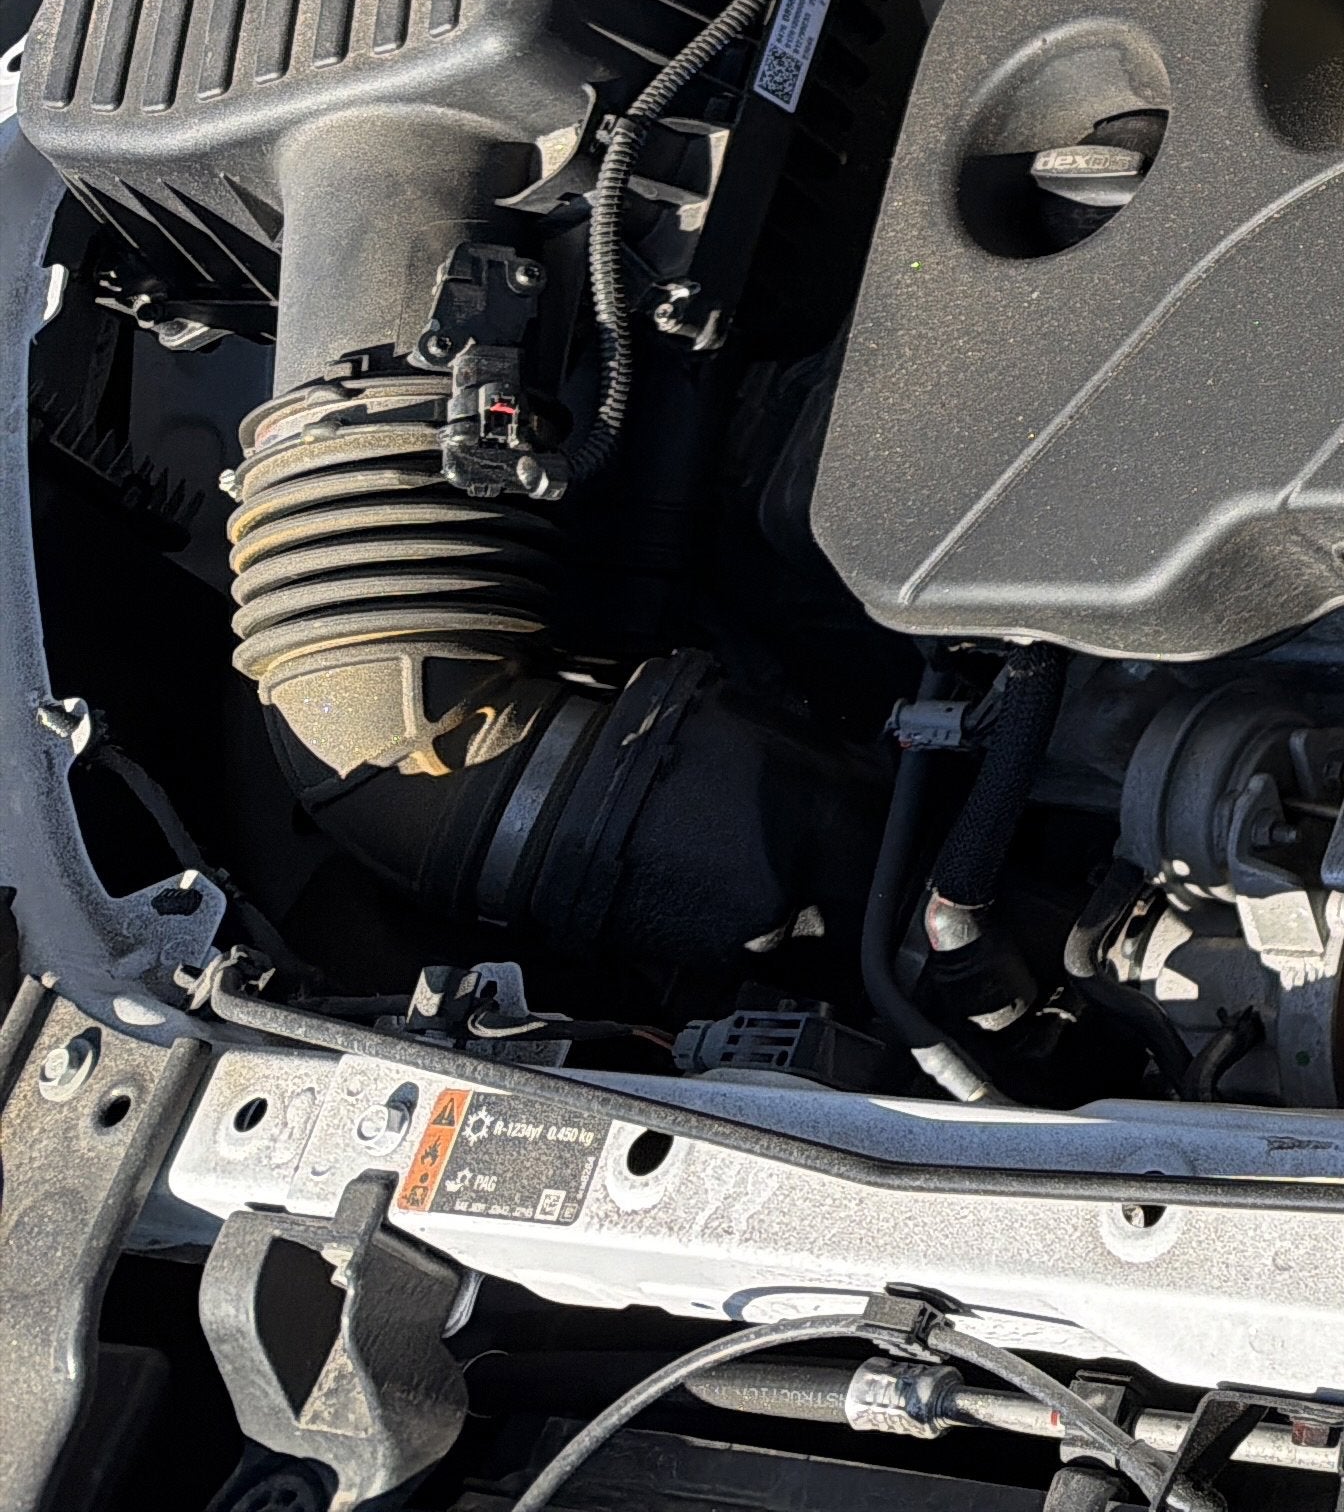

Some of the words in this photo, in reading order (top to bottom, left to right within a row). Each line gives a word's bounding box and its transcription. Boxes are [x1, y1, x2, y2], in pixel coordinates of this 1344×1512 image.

[493, 1120, 543, 1143] R-1234yf
[546, 1125, 576, 1142] 0.450
[577, 1128, 596, 1147] kg
[473, 1174, 498, 1192] PAG
